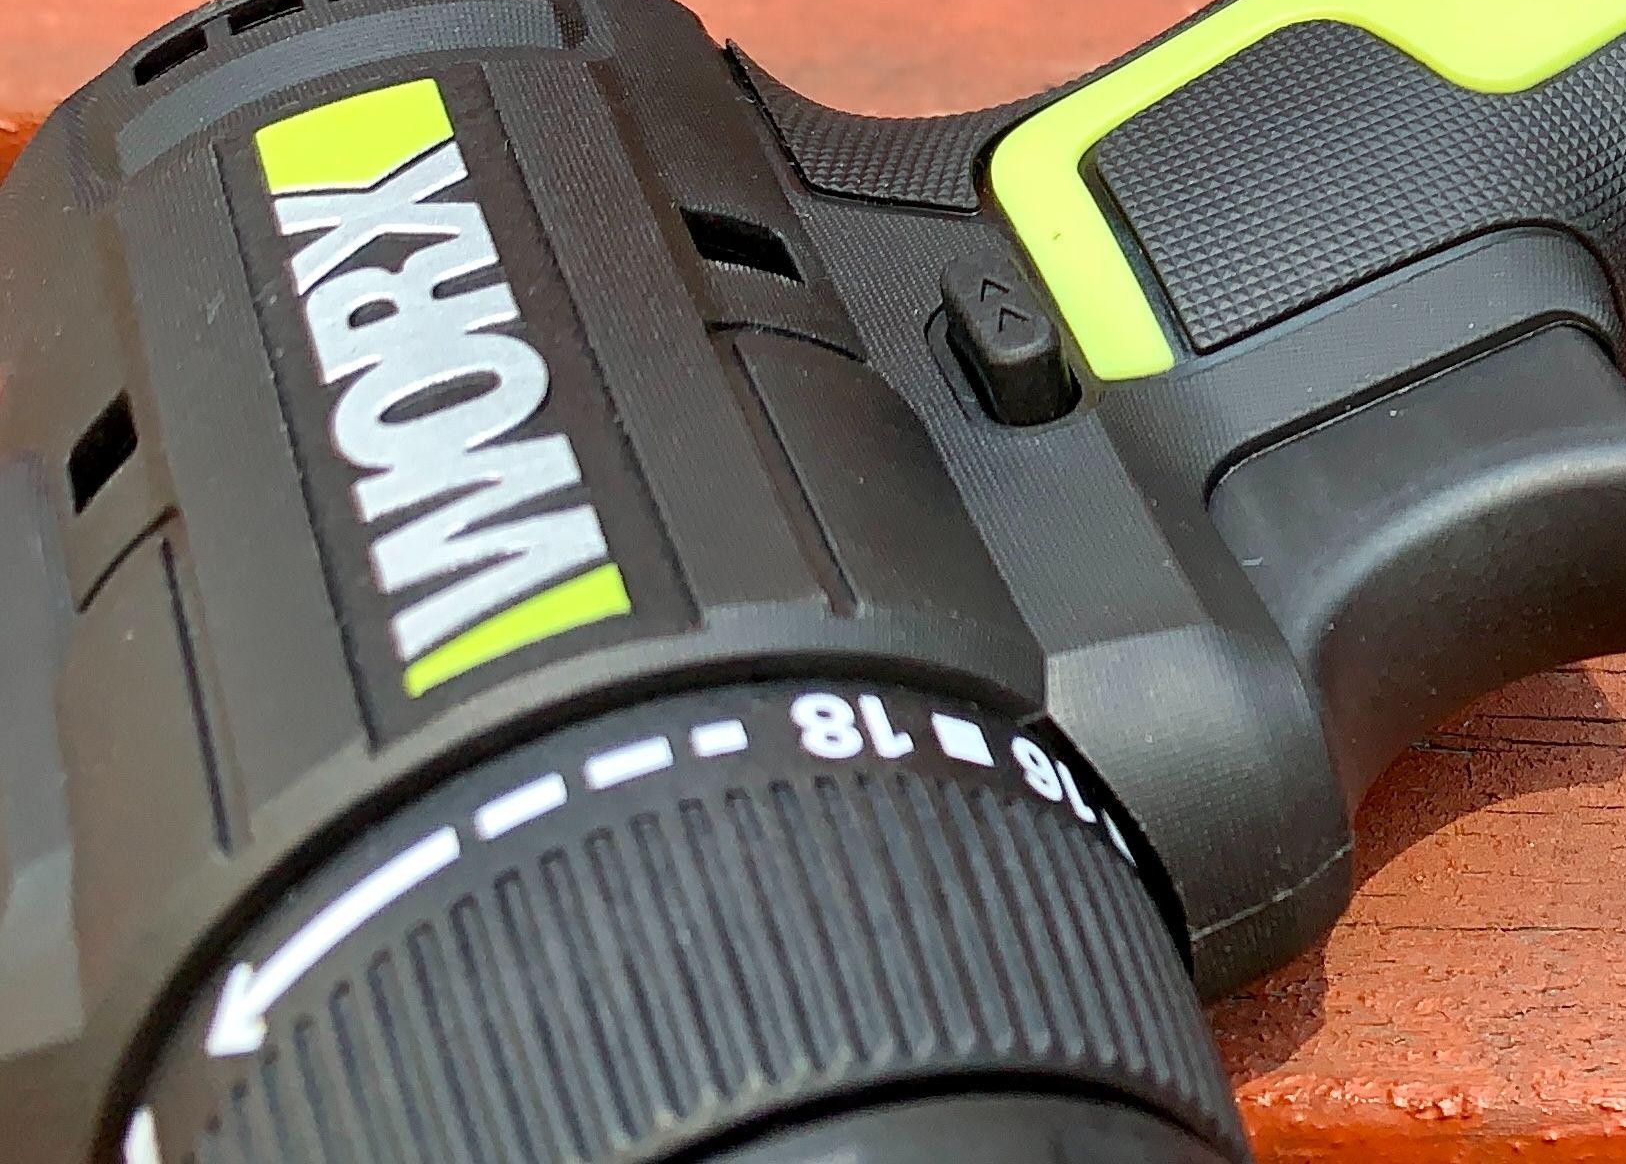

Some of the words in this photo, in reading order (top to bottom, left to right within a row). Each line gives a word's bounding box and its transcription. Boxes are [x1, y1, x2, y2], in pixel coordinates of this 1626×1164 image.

[273, 141, 609, 662] WORX
[790, 692, 915, 760] 18
[1011, 736, 1097, 824] 16
